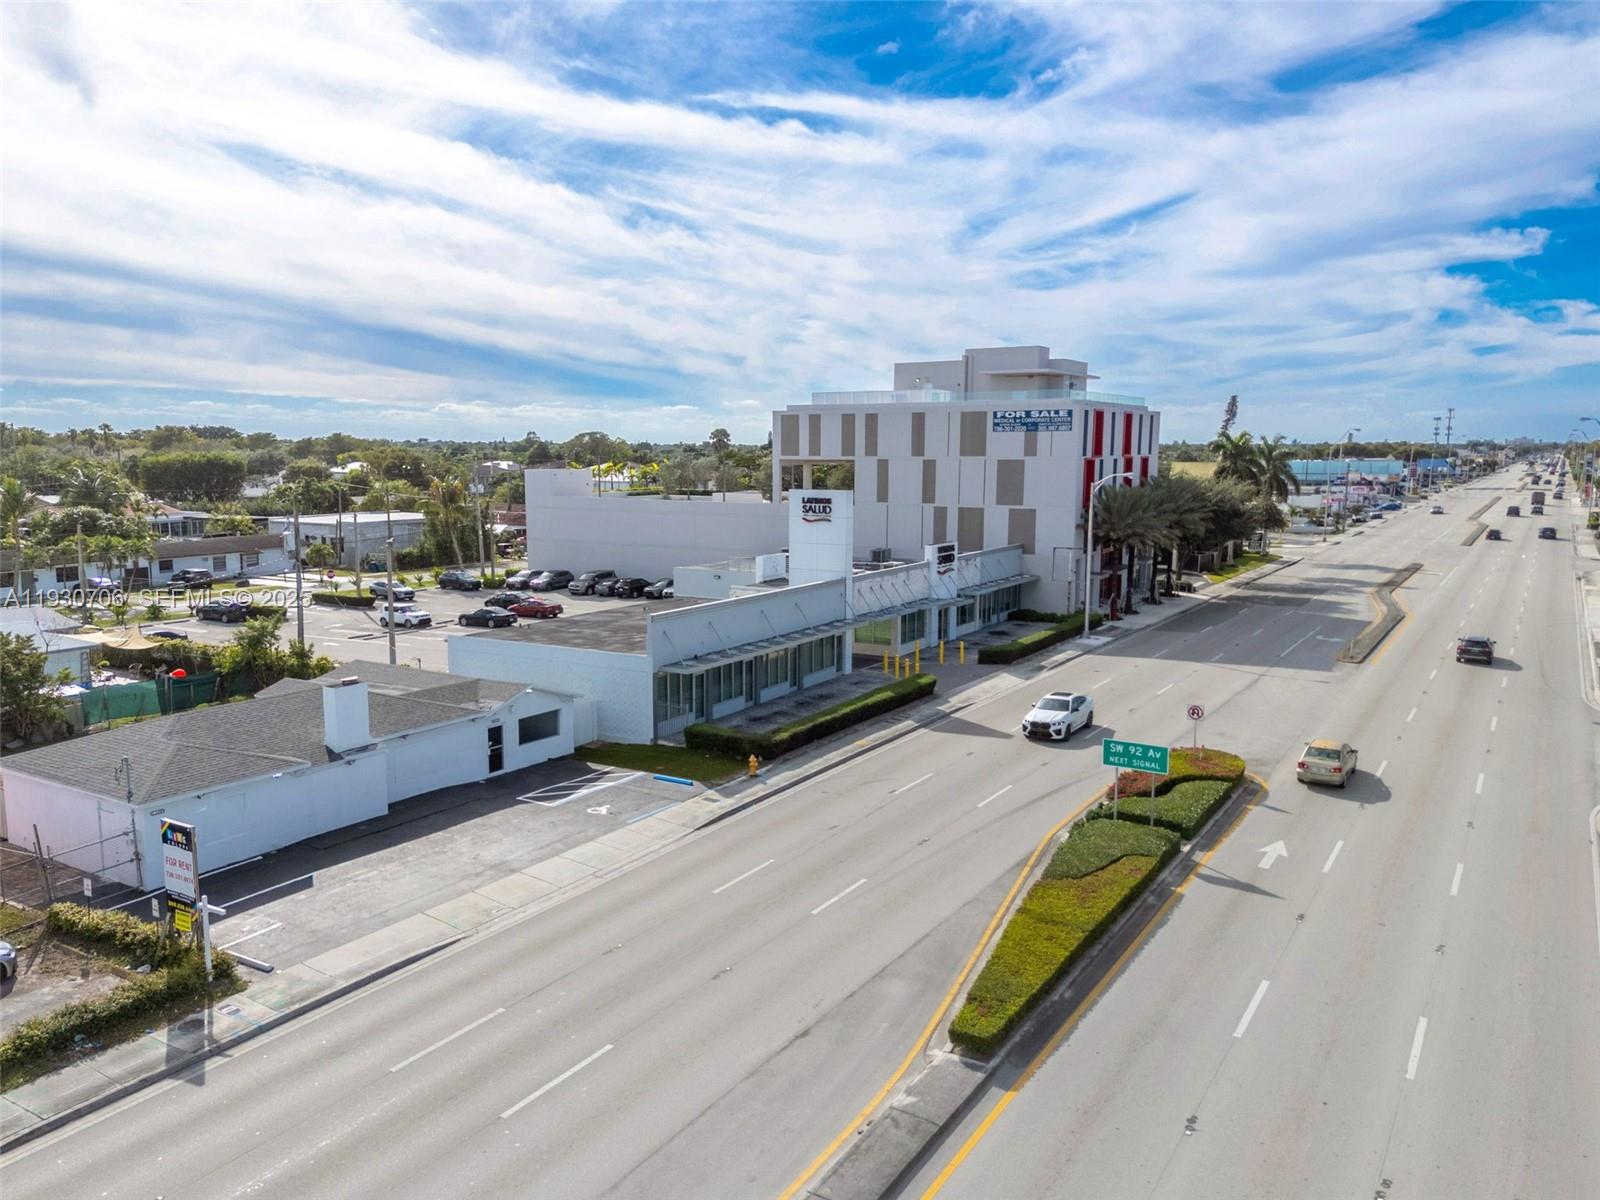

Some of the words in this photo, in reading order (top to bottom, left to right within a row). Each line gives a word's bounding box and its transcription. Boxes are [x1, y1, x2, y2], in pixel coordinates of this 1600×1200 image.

[1030, 410, 1069, 418] SALE
[802, 504, 832, 515] SALUD
[1110, 743, 1124, 753] SW
[1129, 745, 1143, 757] 92
[1147, 748, 1161, 759] Av
[1109, 756, 1128, 765] NEXT
[1132, 759, 1161, 770] SIGNAL
[165, 856, 178, 868] FOR
[178, 861, 193, 873] RENT
